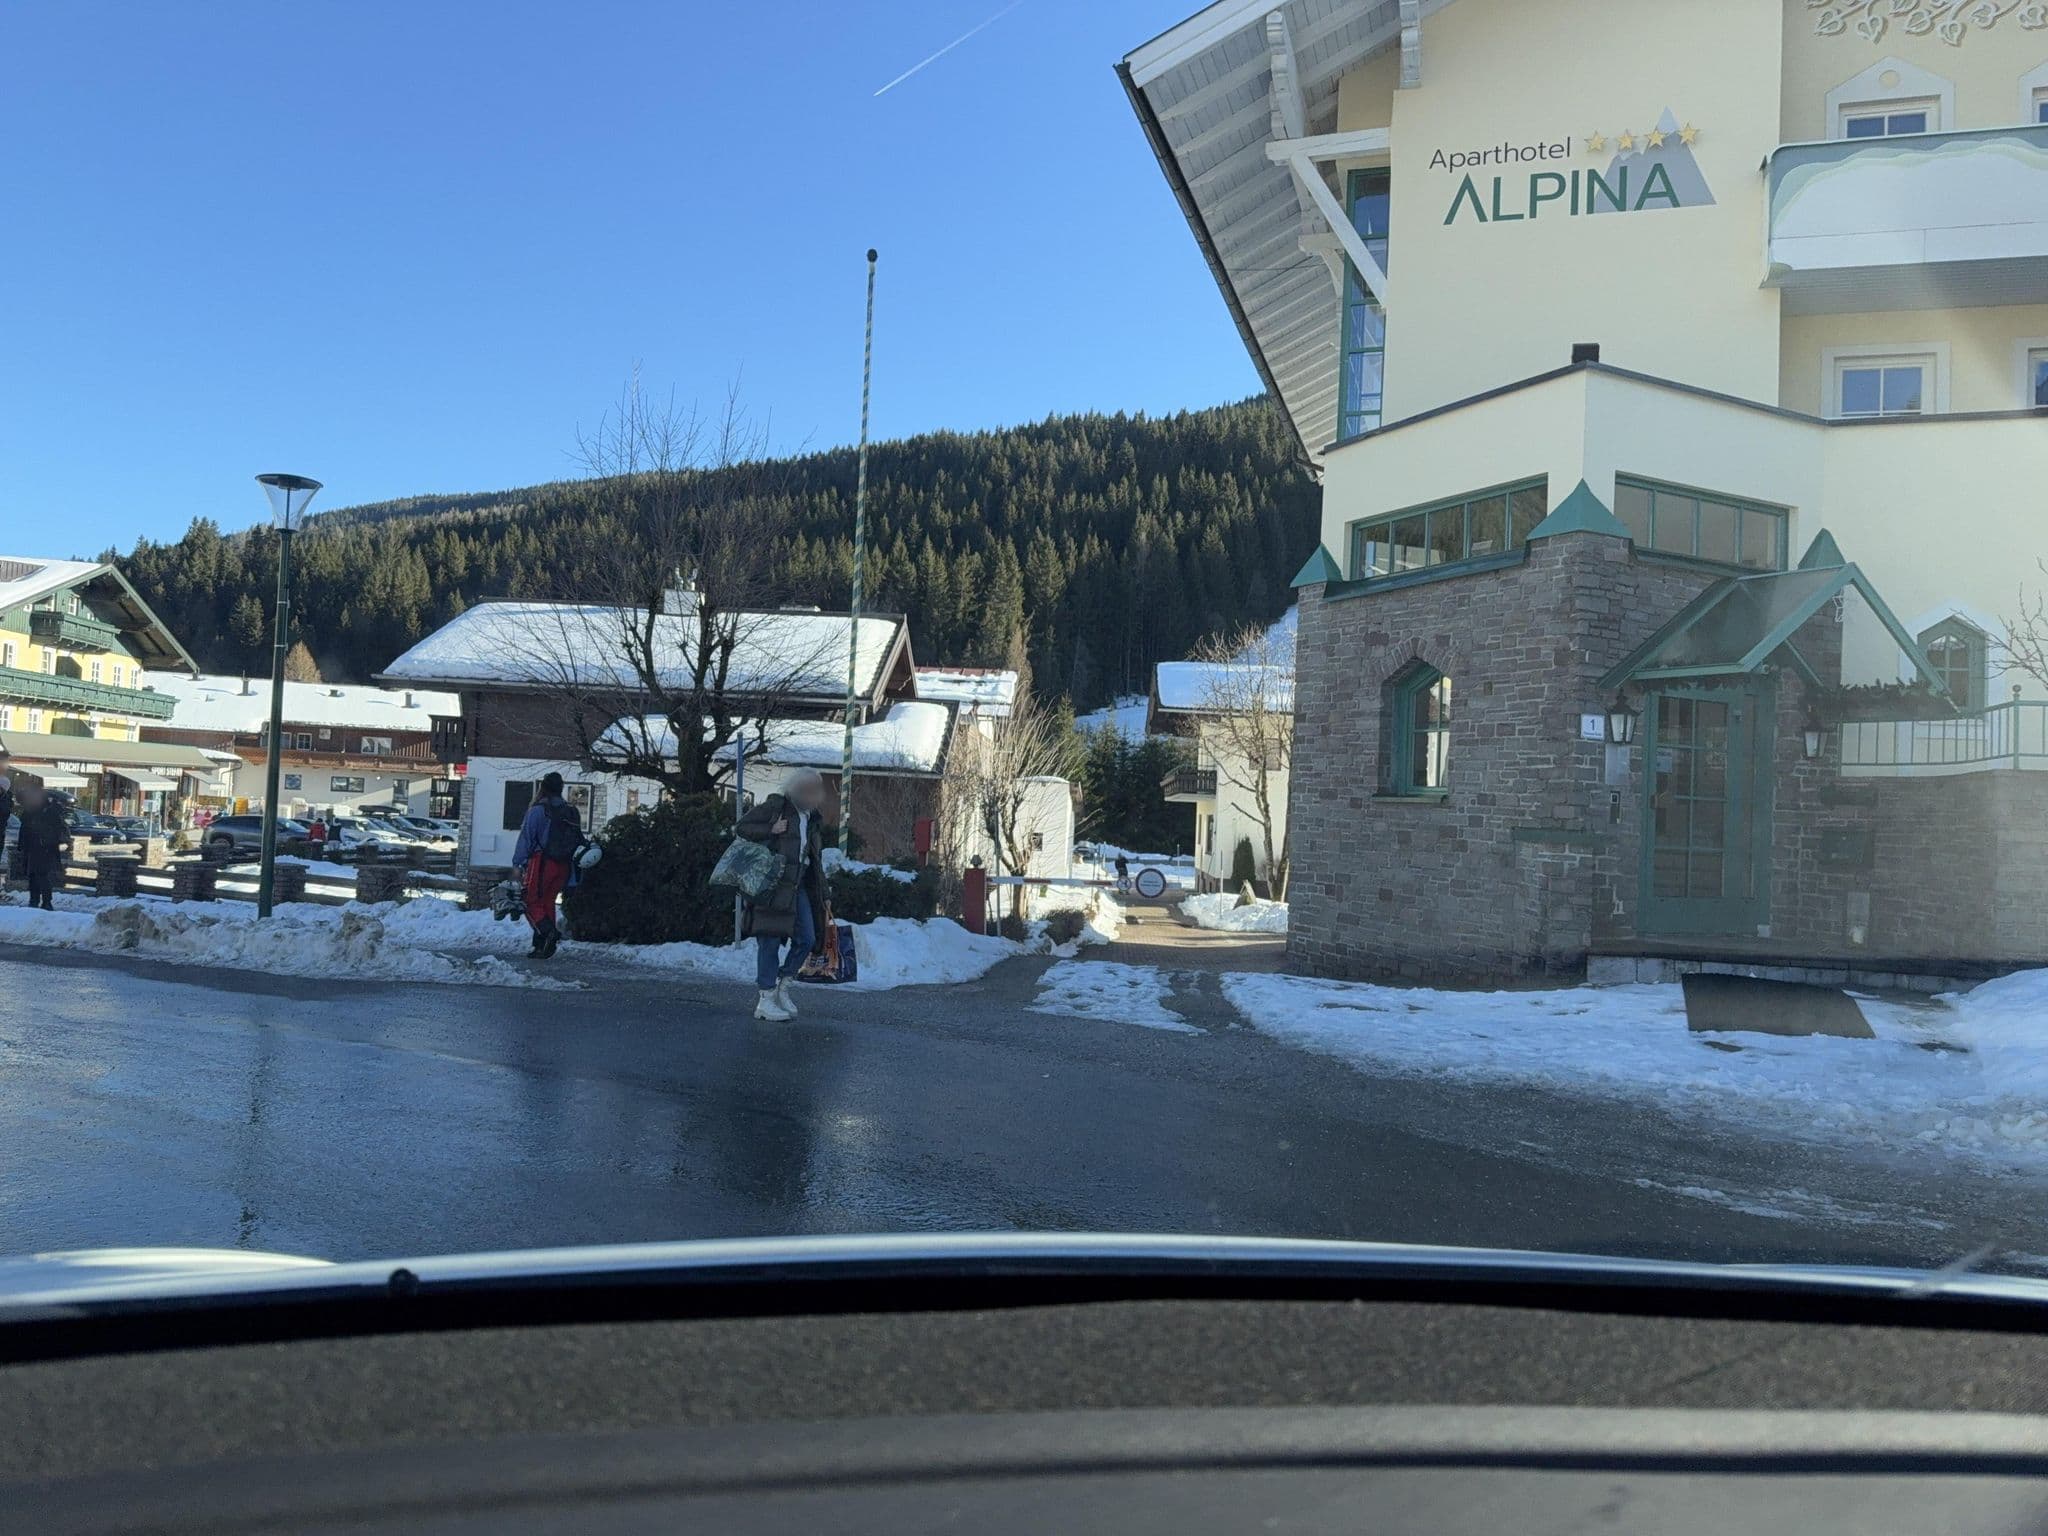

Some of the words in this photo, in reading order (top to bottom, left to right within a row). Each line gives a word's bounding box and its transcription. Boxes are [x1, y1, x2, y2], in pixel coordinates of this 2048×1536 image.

[1429, 136, 1571, 173] Aparthotel
[1443, 163, 1681, 225] ALPINA
[1590, 719, 1595, 731] 1
